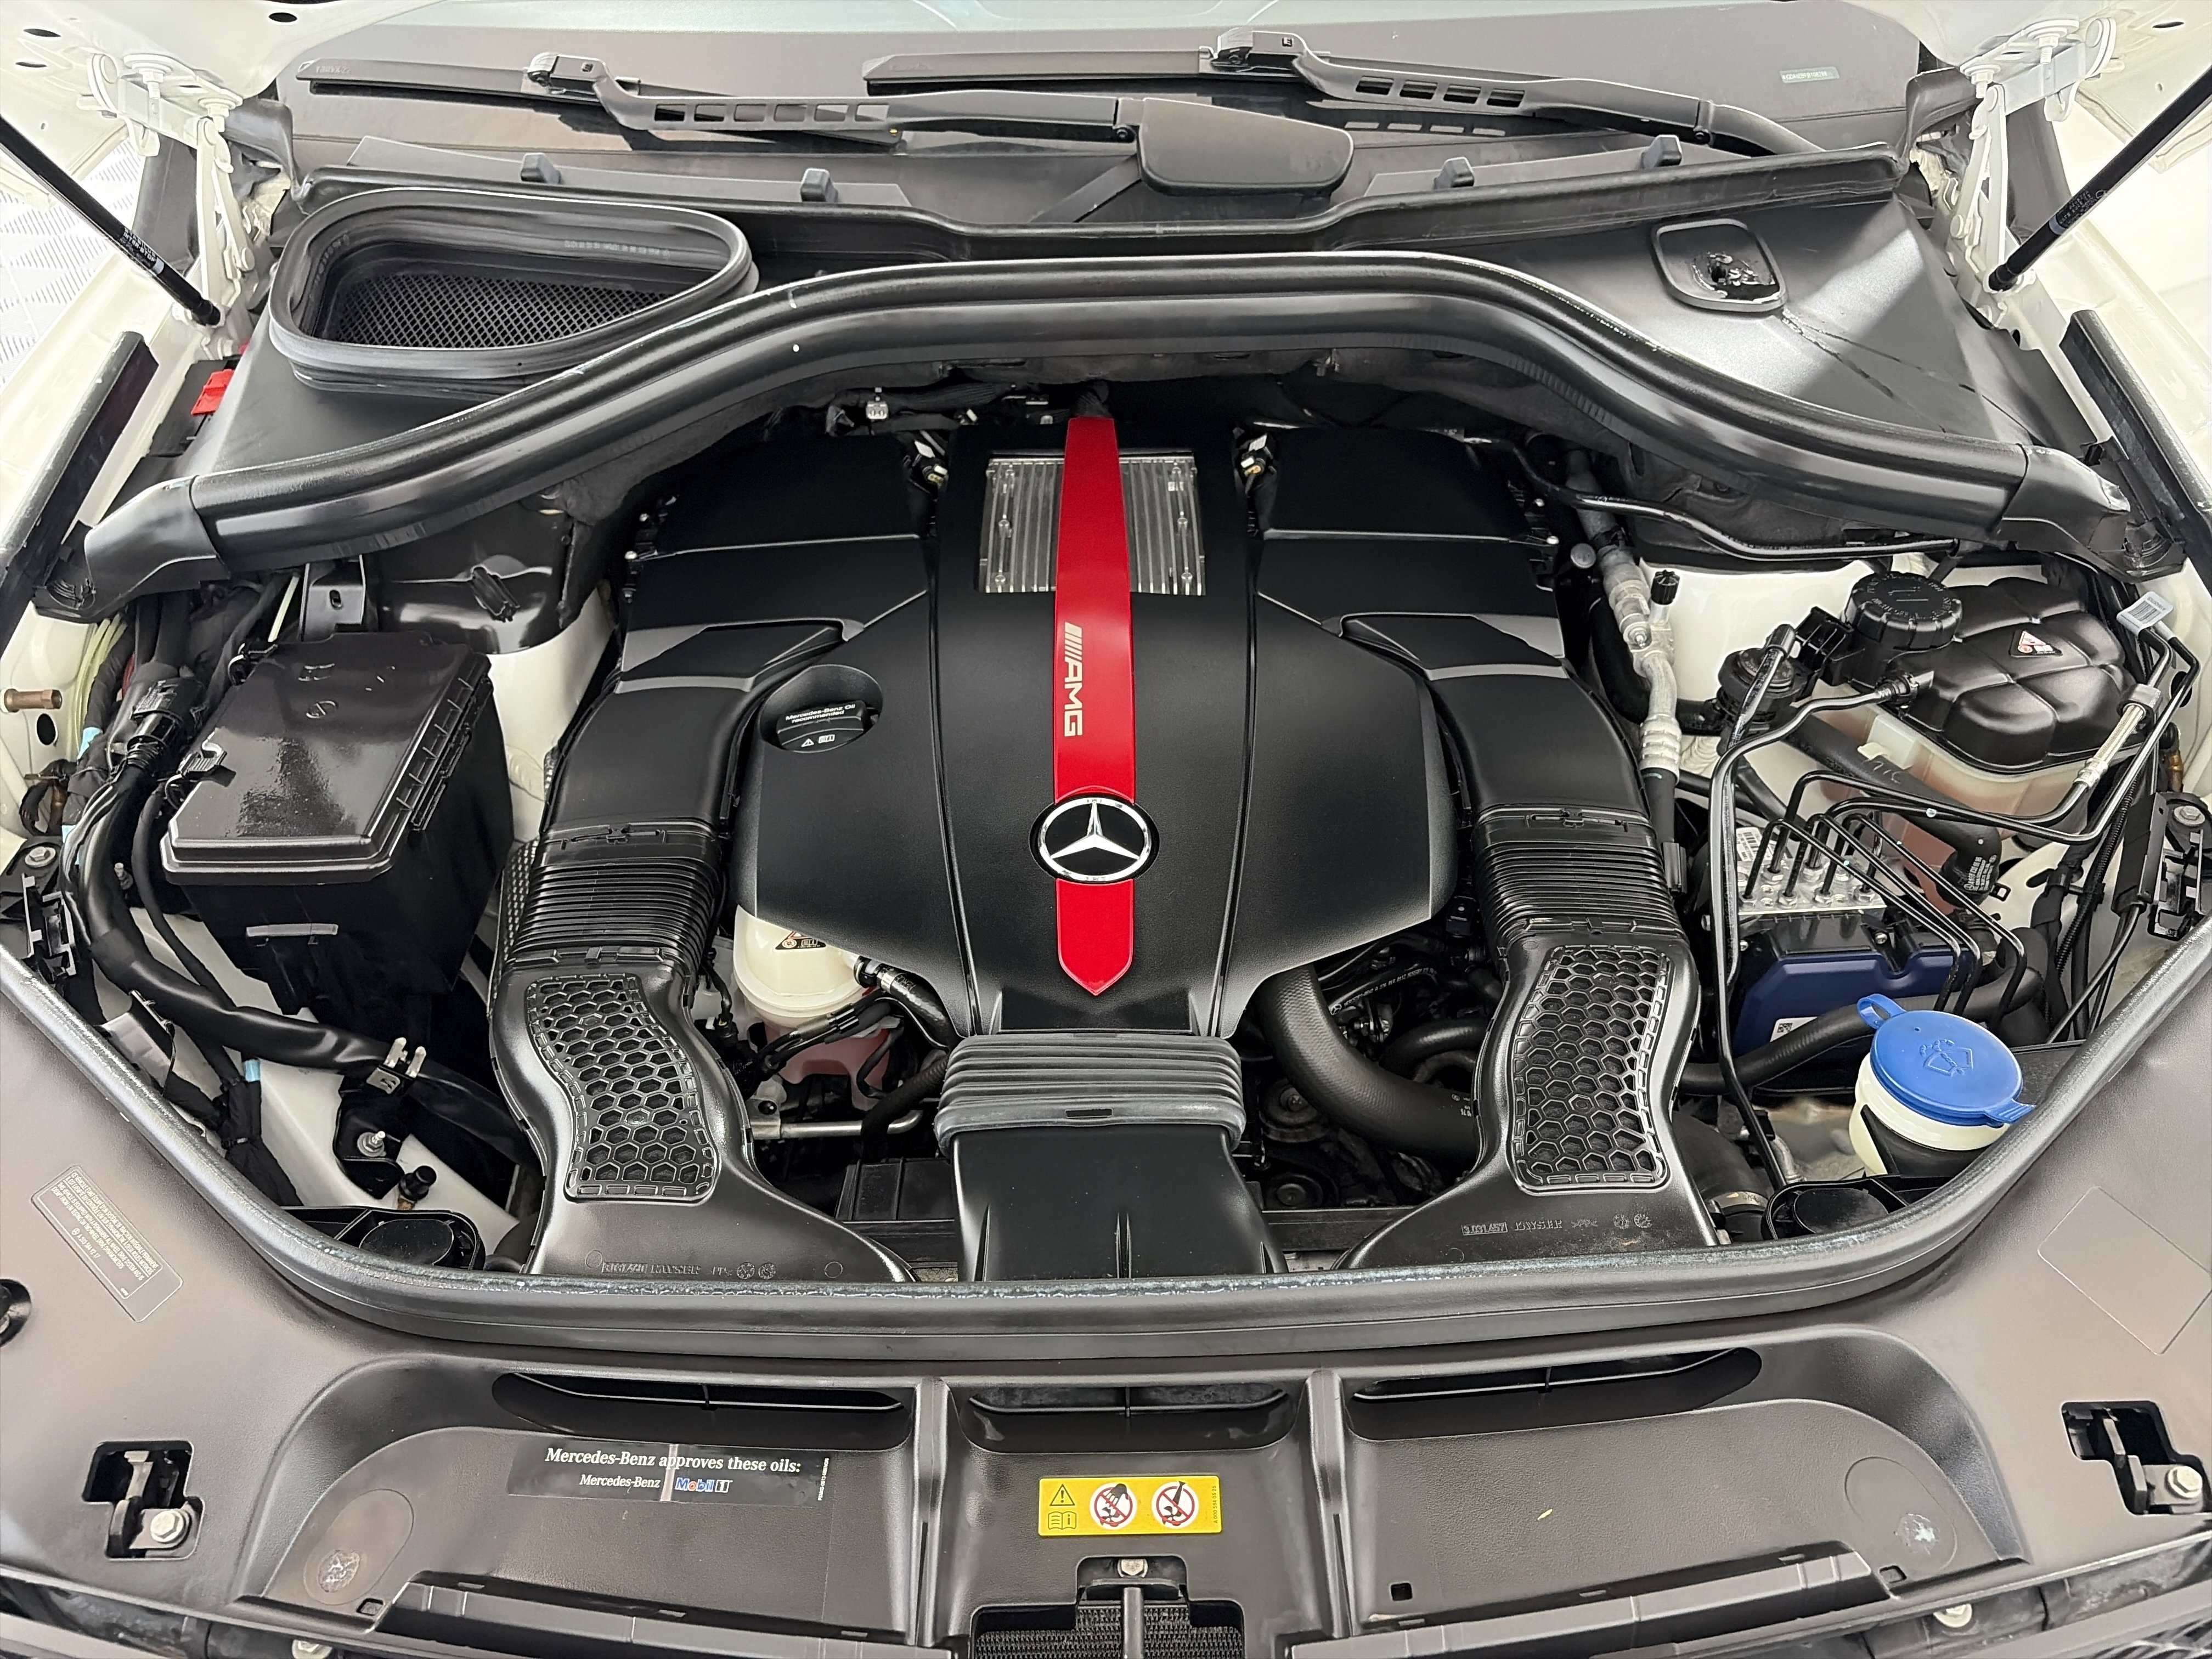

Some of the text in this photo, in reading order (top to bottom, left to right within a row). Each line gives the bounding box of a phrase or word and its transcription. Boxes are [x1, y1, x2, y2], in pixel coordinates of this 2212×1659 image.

[786, 706, 843, 720] Mercedes-Benz
[792, 710, 844, 723] recommended
[57, 1182, 66, 1190] THIS
[61, 1188, 75, 1200] VEHICLE
[73, 1201, 88, 1216] EQUIPPED
[1514, 1220, 1562, 1231] KAYSER
[123, 1259, 137, 1272] SYSTEM
[544, 1448, 801, 1472] Mercedes-Benz approves these oils:
[579, 1474, 661, 1488] Mercedes-Benz
[675, 1477, 714, 1492] Mobil
